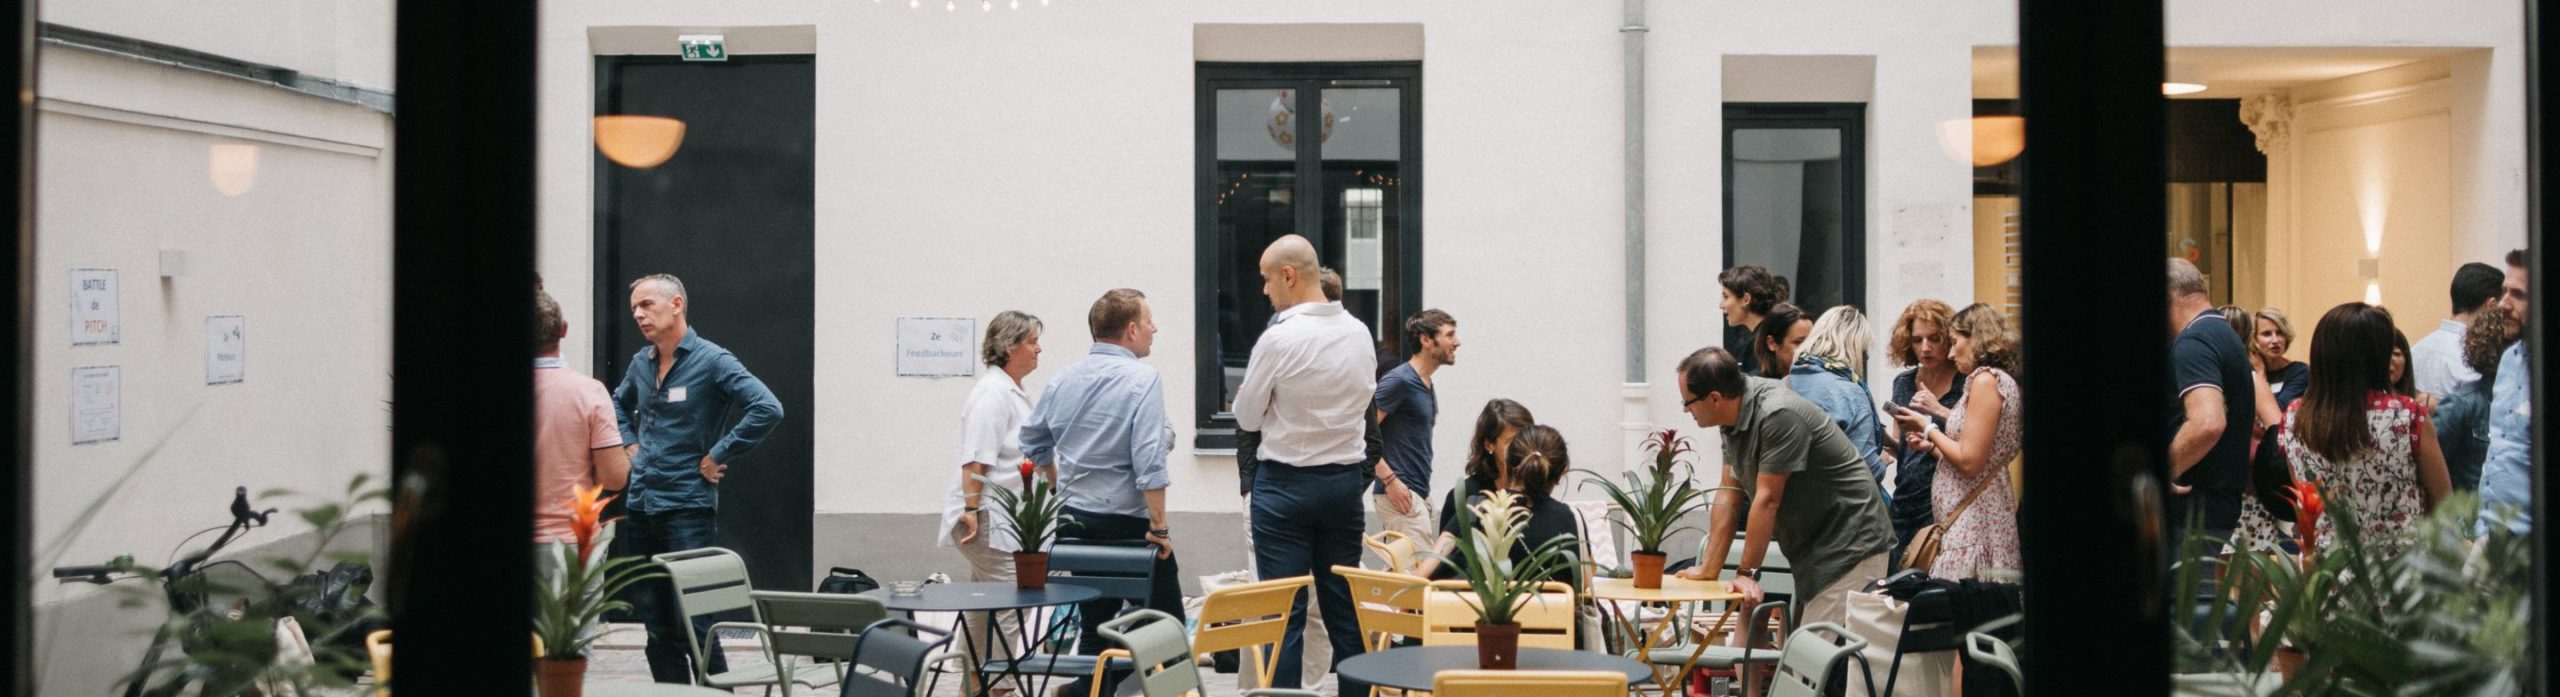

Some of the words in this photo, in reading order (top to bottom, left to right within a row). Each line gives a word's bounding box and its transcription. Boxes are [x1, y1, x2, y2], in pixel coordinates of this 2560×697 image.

[82, 279, 106, 291] BATTLE
[90, 299, 100, 311] de
[85, 320, 107, 333] PITCH
[931, 332, 941, 340] Ze
